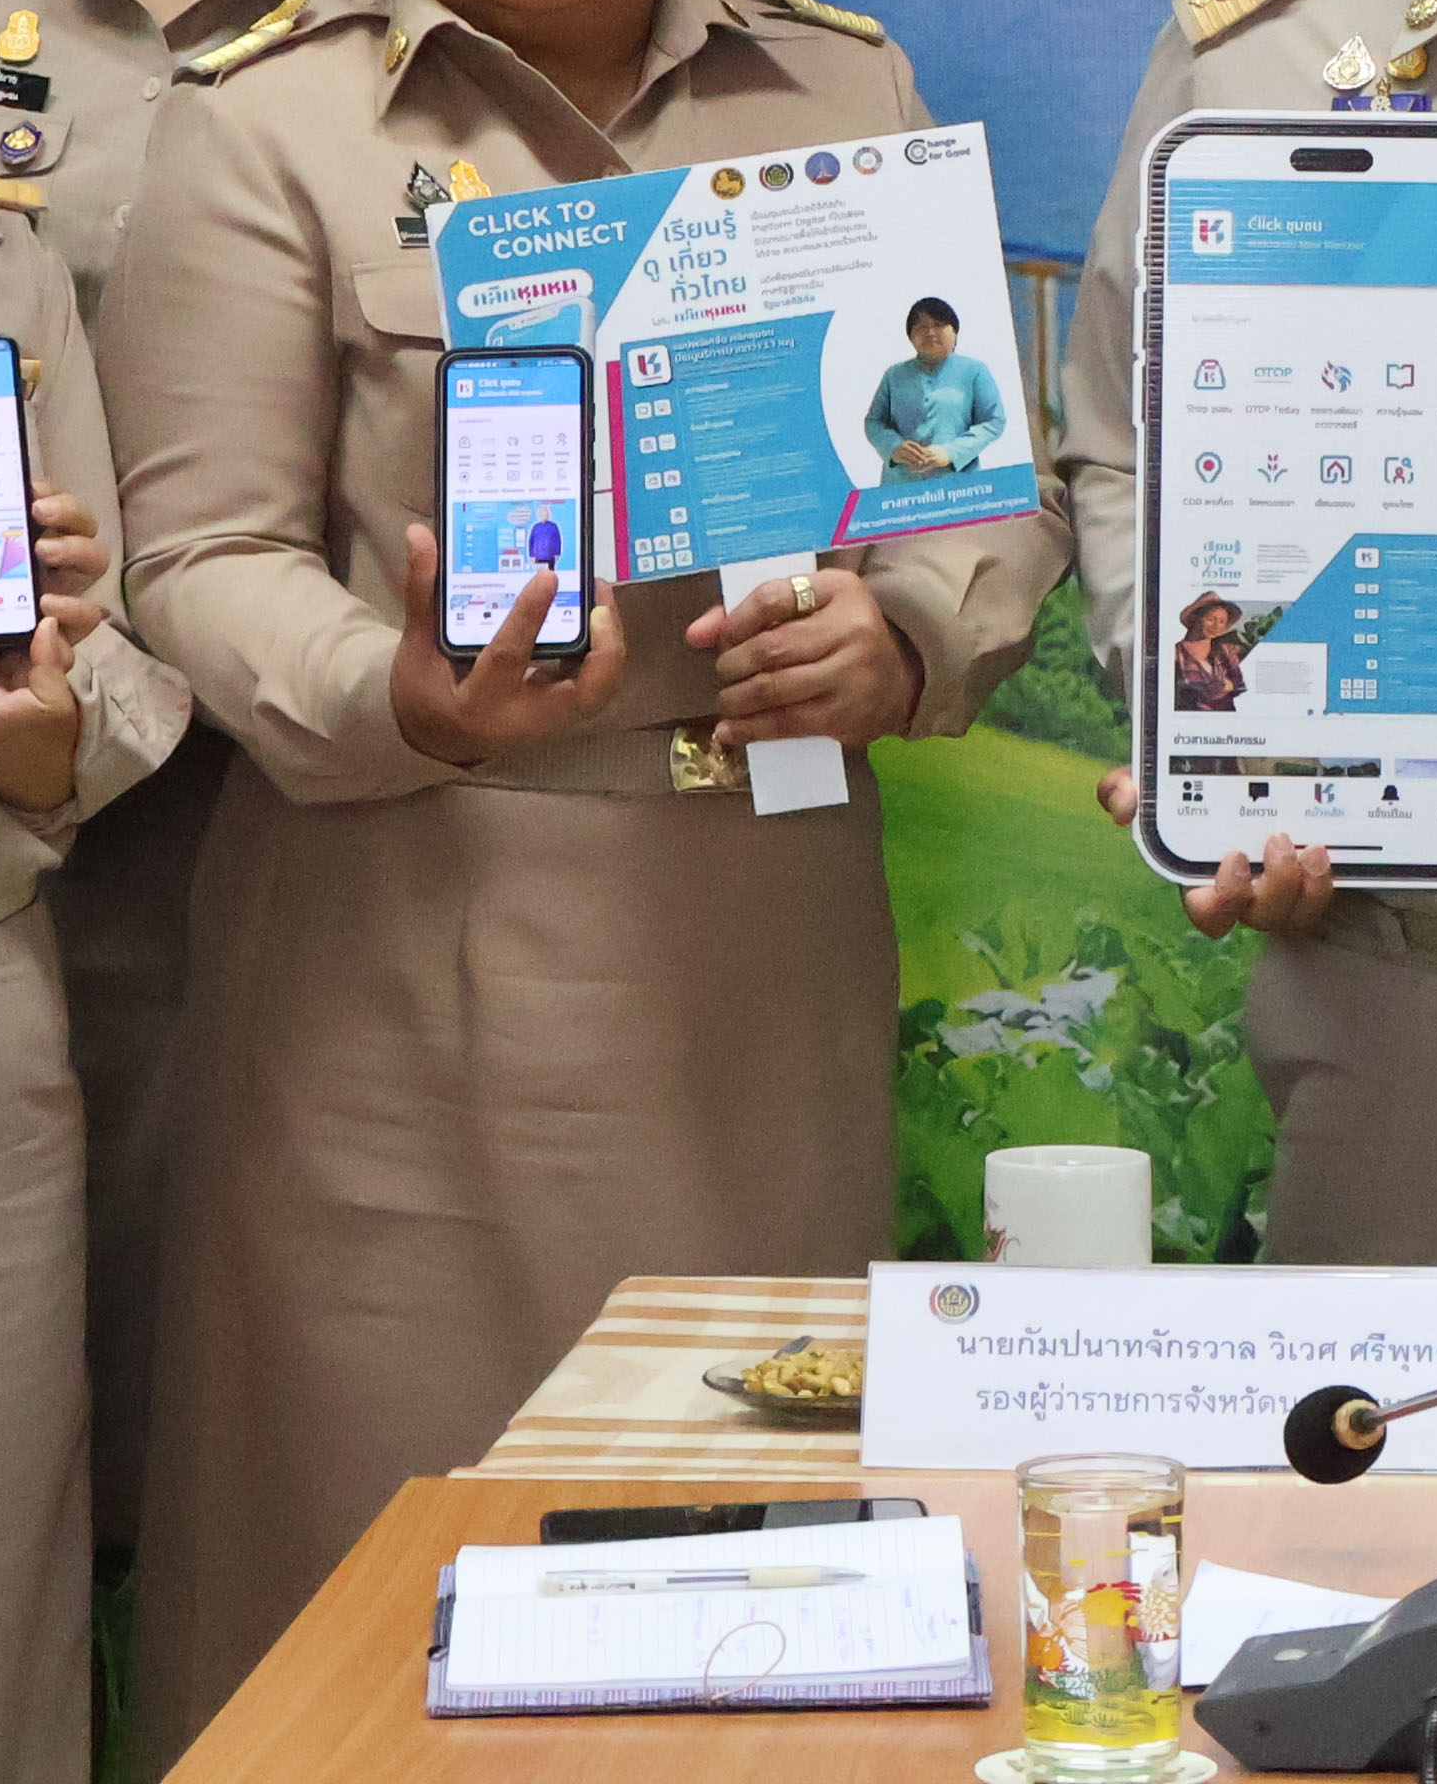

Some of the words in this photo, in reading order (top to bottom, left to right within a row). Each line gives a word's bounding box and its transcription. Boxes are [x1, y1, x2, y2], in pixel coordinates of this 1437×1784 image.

[467, 205, 552, 237] CLICK
[557, 199, 596, 224] TO
[664, 209, 736, 242] เรียนรู้
[1247, 216, 1282, 232] Click
[1286, 221, 1323, 234] ชุมชน
[492, 220, 628, 260] CONNECT
[644, 259, 659, 283] ดู
[669, 241, 727, 272] เที่ยว
[473, 279, 578, 306] คลิกชุมชน
[671, 273, 747, 303] ทั่วไทย
[1254, 366, 1293, 378] OTOP
[1173, 733, 1267, 746] ข่าวสารและกิจกรรม
[1177, 806, 1209, 816] บริการ
[1239, 805, 1278, 817] ข้อความ
[956, 1326, 1256, 1360] นายกัมปนาทจักรวาล
[1268, 1330, 1337, 1362] วิเวศ
